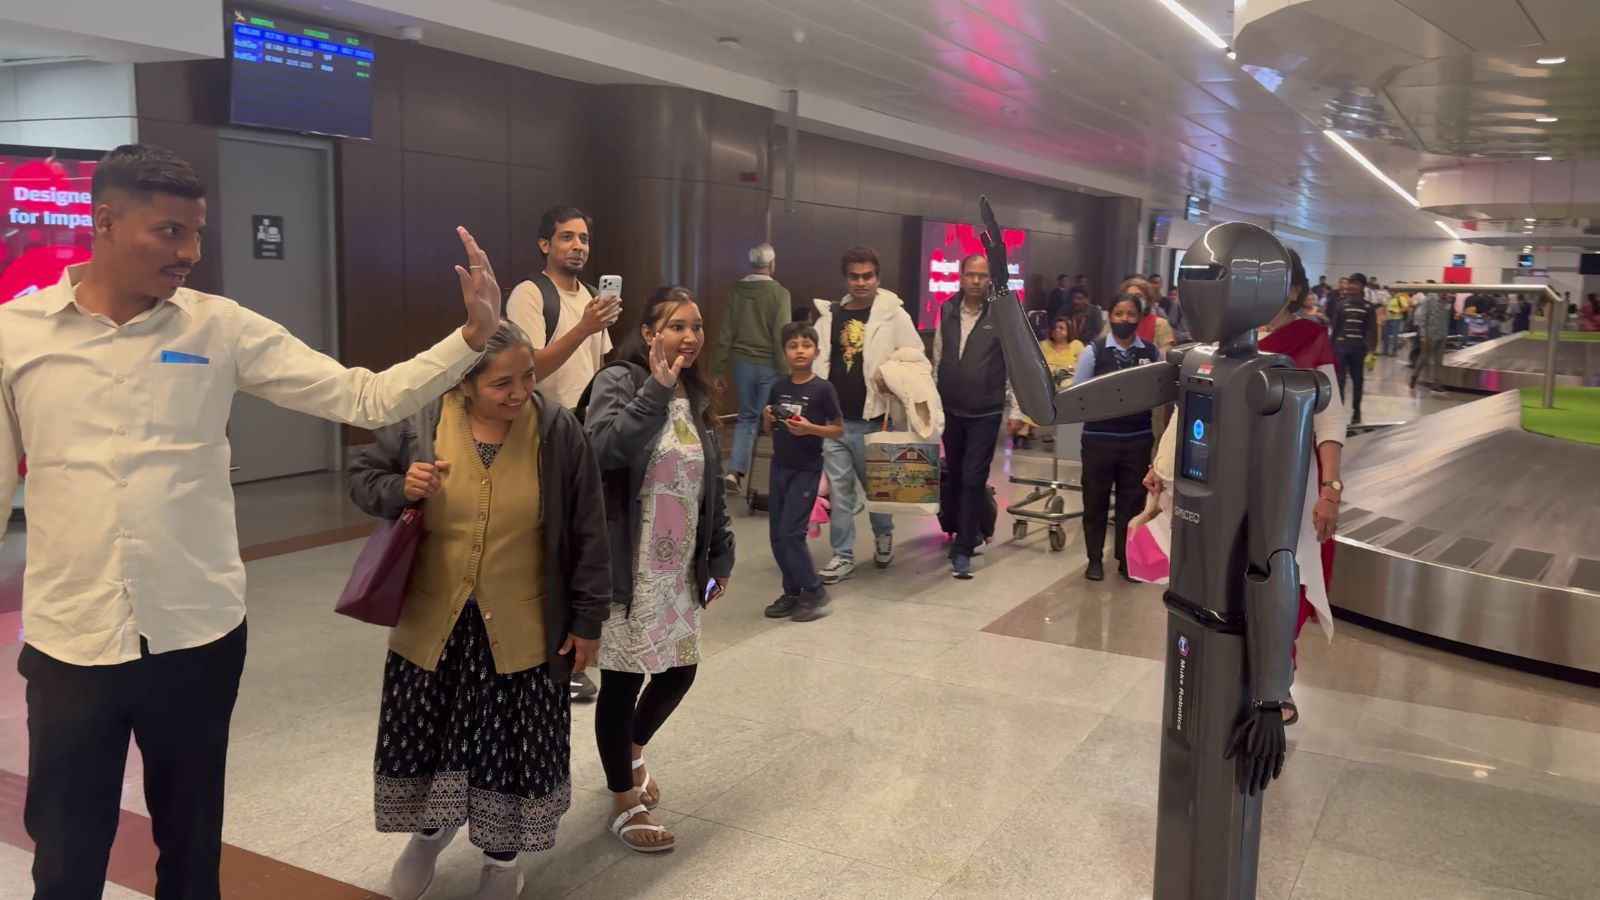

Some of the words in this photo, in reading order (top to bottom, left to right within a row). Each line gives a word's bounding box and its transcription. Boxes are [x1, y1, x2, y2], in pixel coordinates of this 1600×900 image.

[14, 186, 92, 206] Designe
[9, 208, 39, 224] for
[43, 211, 93, 229] Impa
[1177, 687, 1185, 731] Robotics
